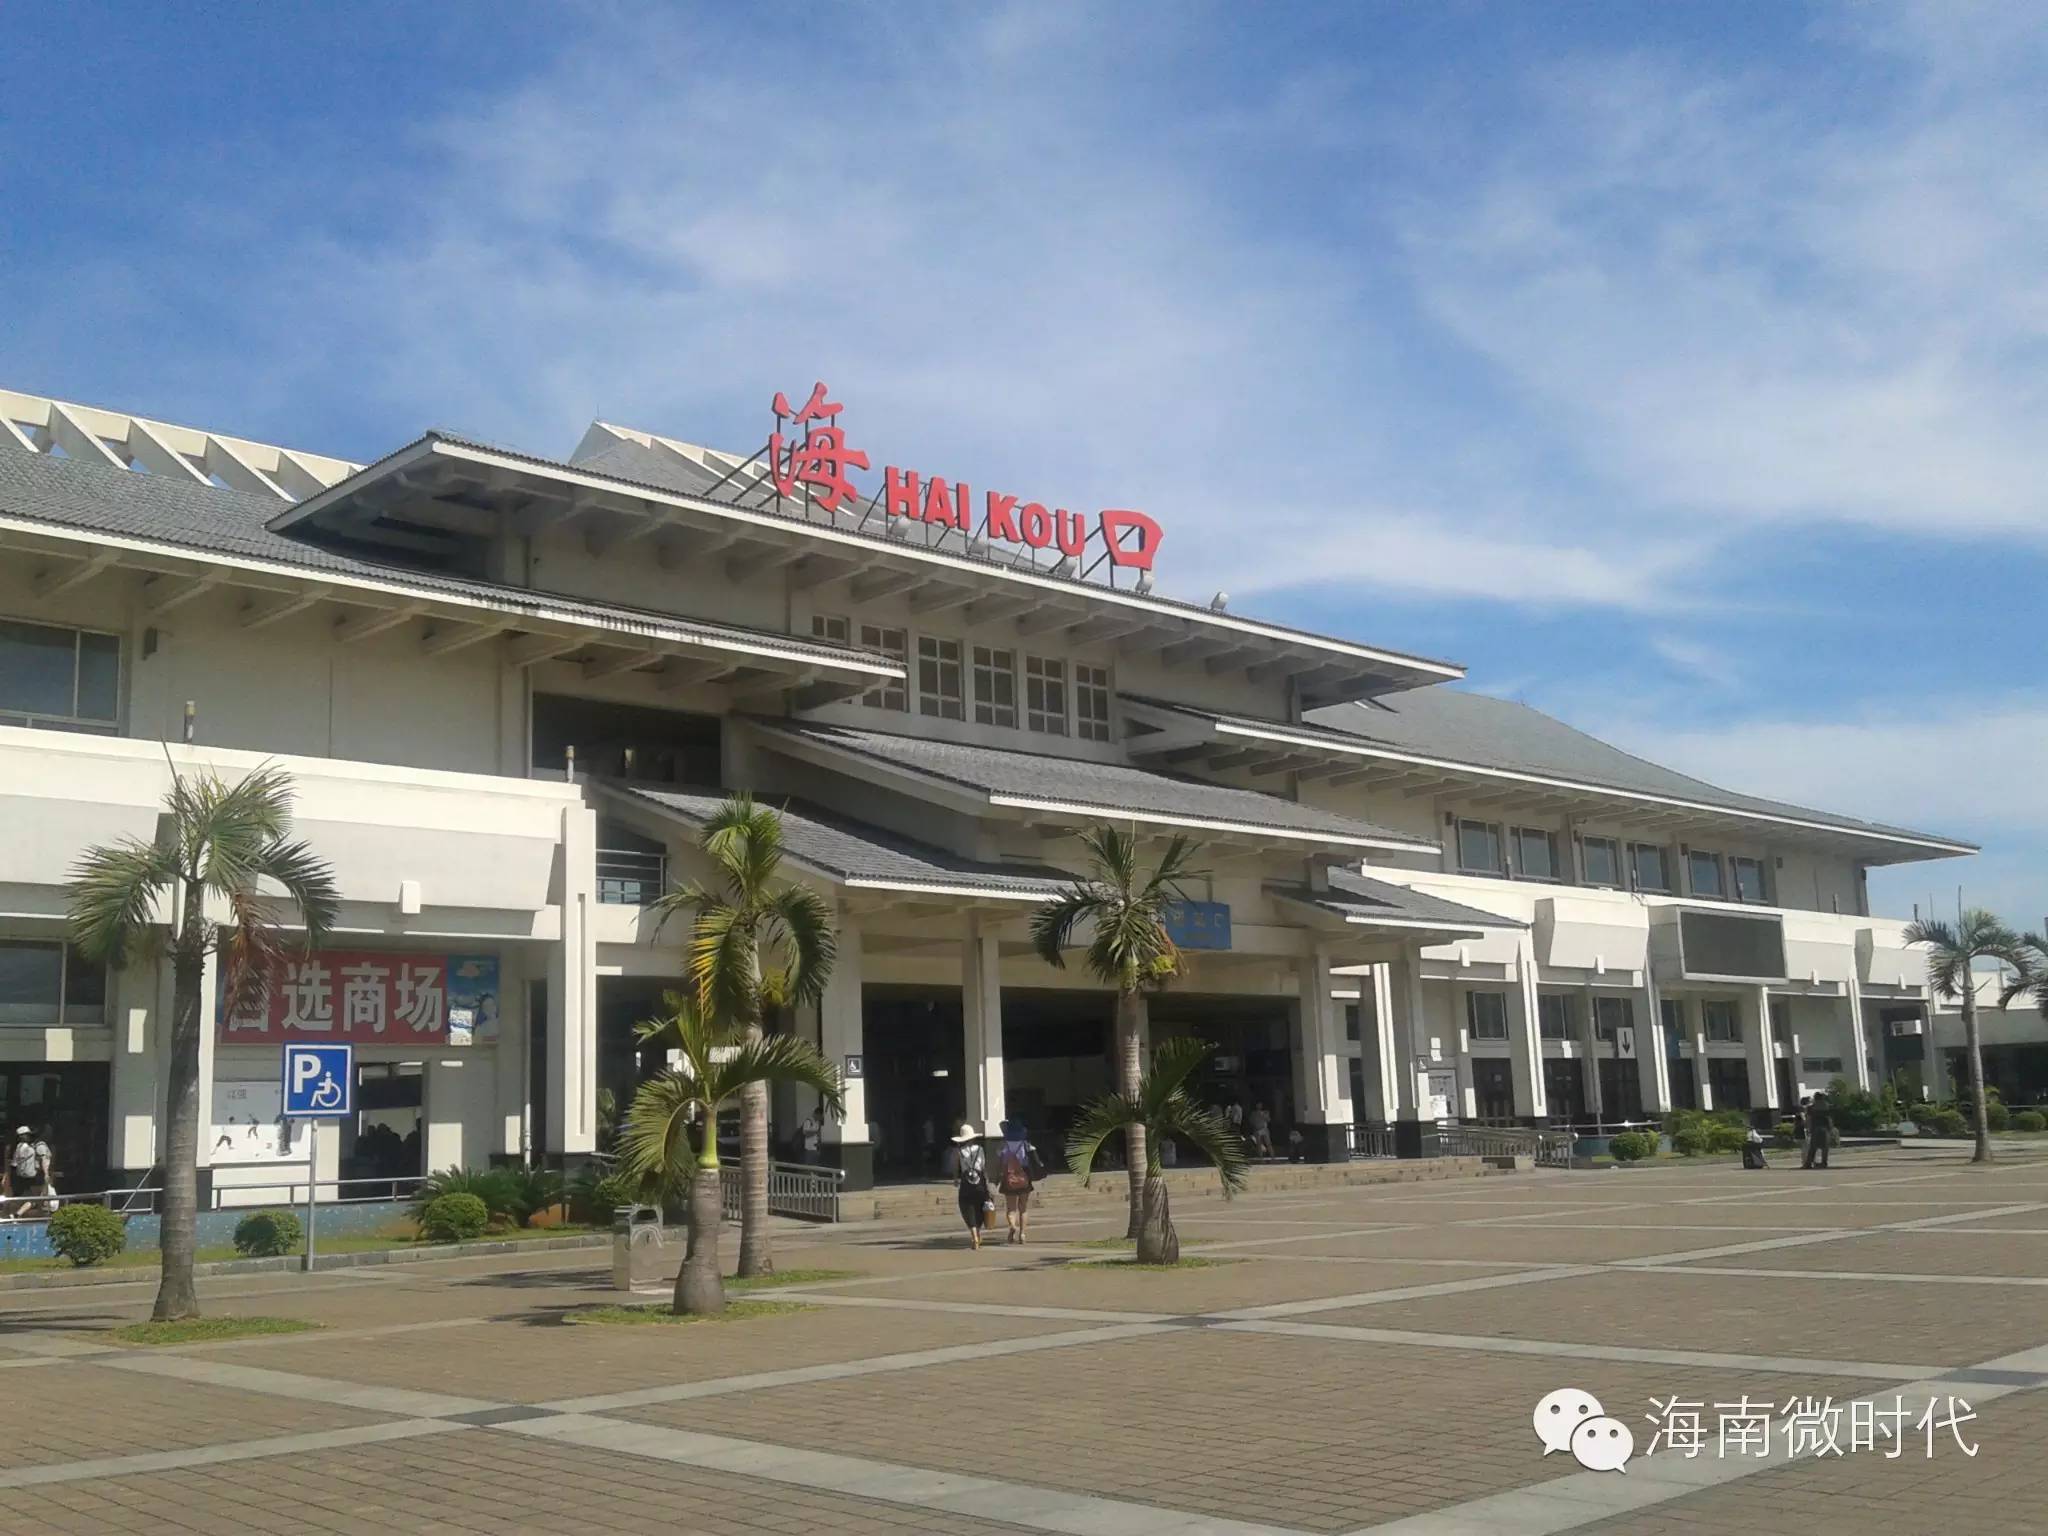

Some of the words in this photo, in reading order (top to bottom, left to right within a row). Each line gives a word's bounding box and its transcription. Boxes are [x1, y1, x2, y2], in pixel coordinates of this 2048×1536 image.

[769, 381, 870, 512] 海
[885, 465, 970, 532] HAI
[986, 490, 1086, 556] KOU
[1100, 509, 1163, 570] 口
[294, 1054, 321, 1094] P
